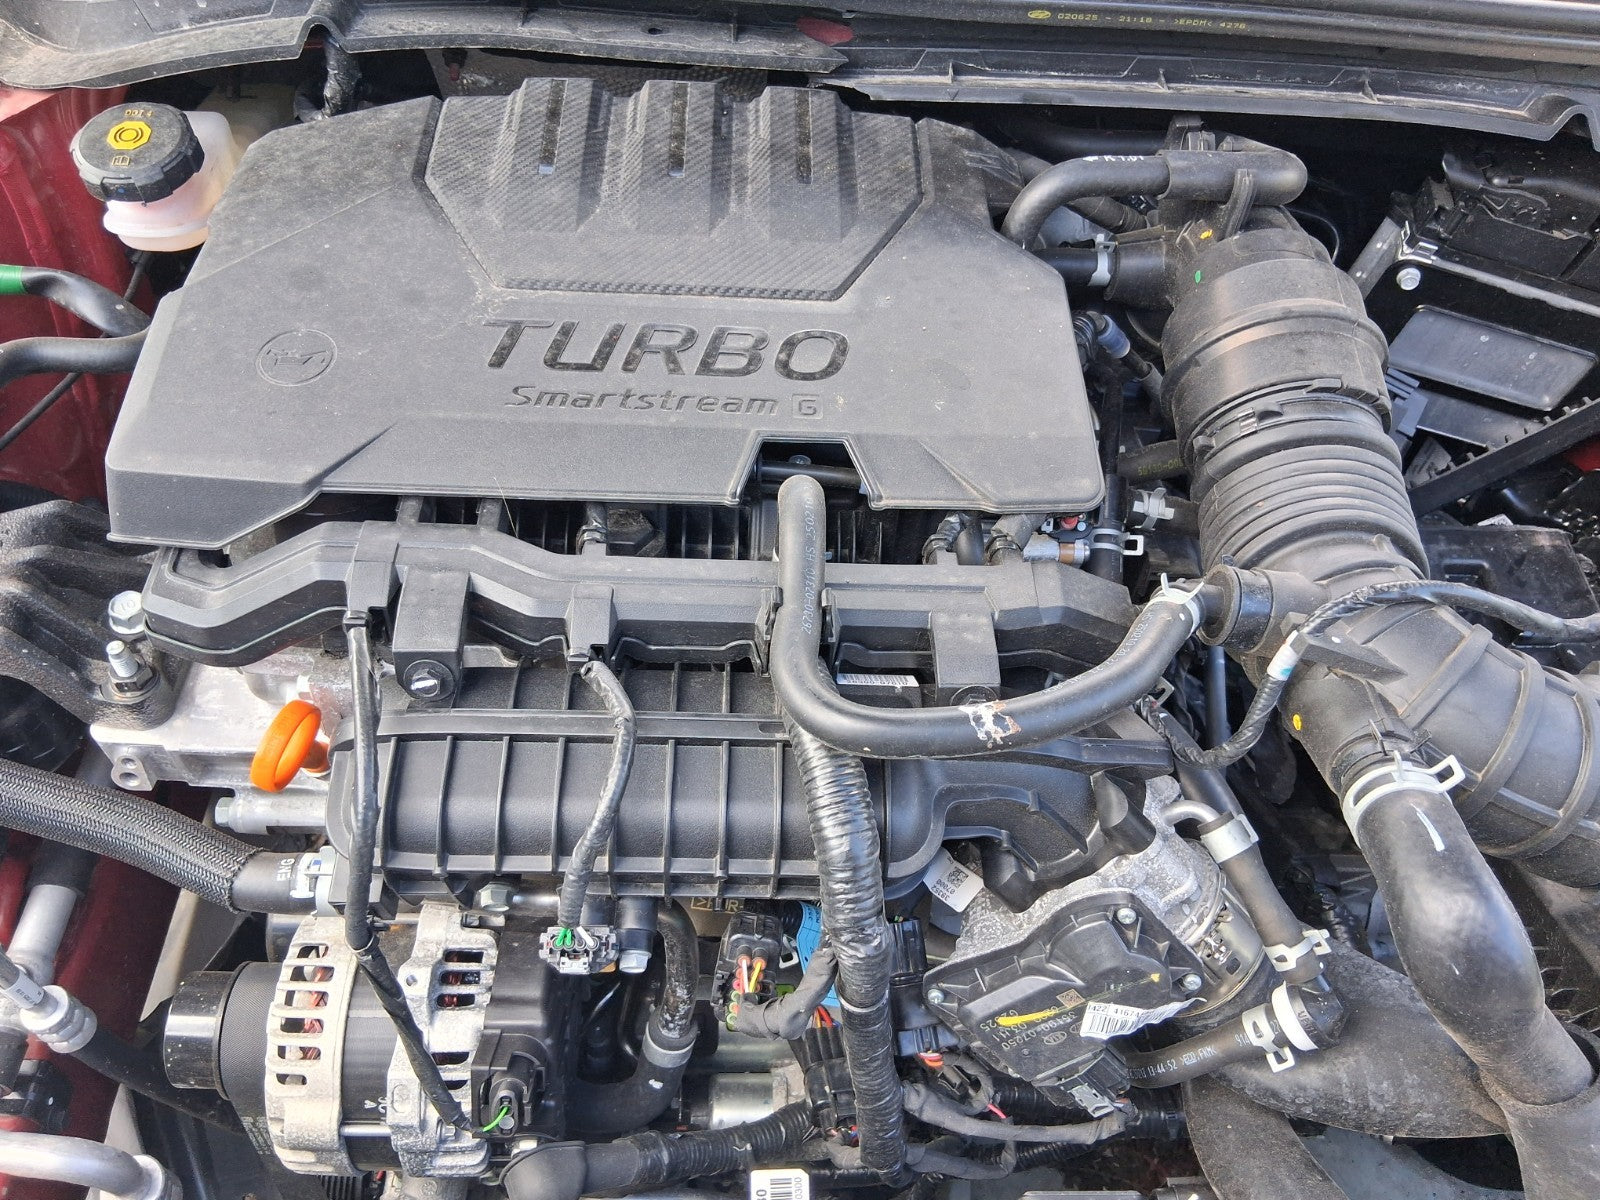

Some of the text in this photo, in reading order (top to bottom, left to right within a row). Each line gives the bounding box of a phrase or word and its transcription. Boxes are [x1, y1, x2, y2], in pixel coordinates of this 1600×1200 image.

[125, 109, 144, 117] DOT
[484, 320, 850, 382] TURBO
[504, 385, 821, 418] Smartstream G
[806, 546, 815, 562] HS
[277, 858, 296, 882] ENG
